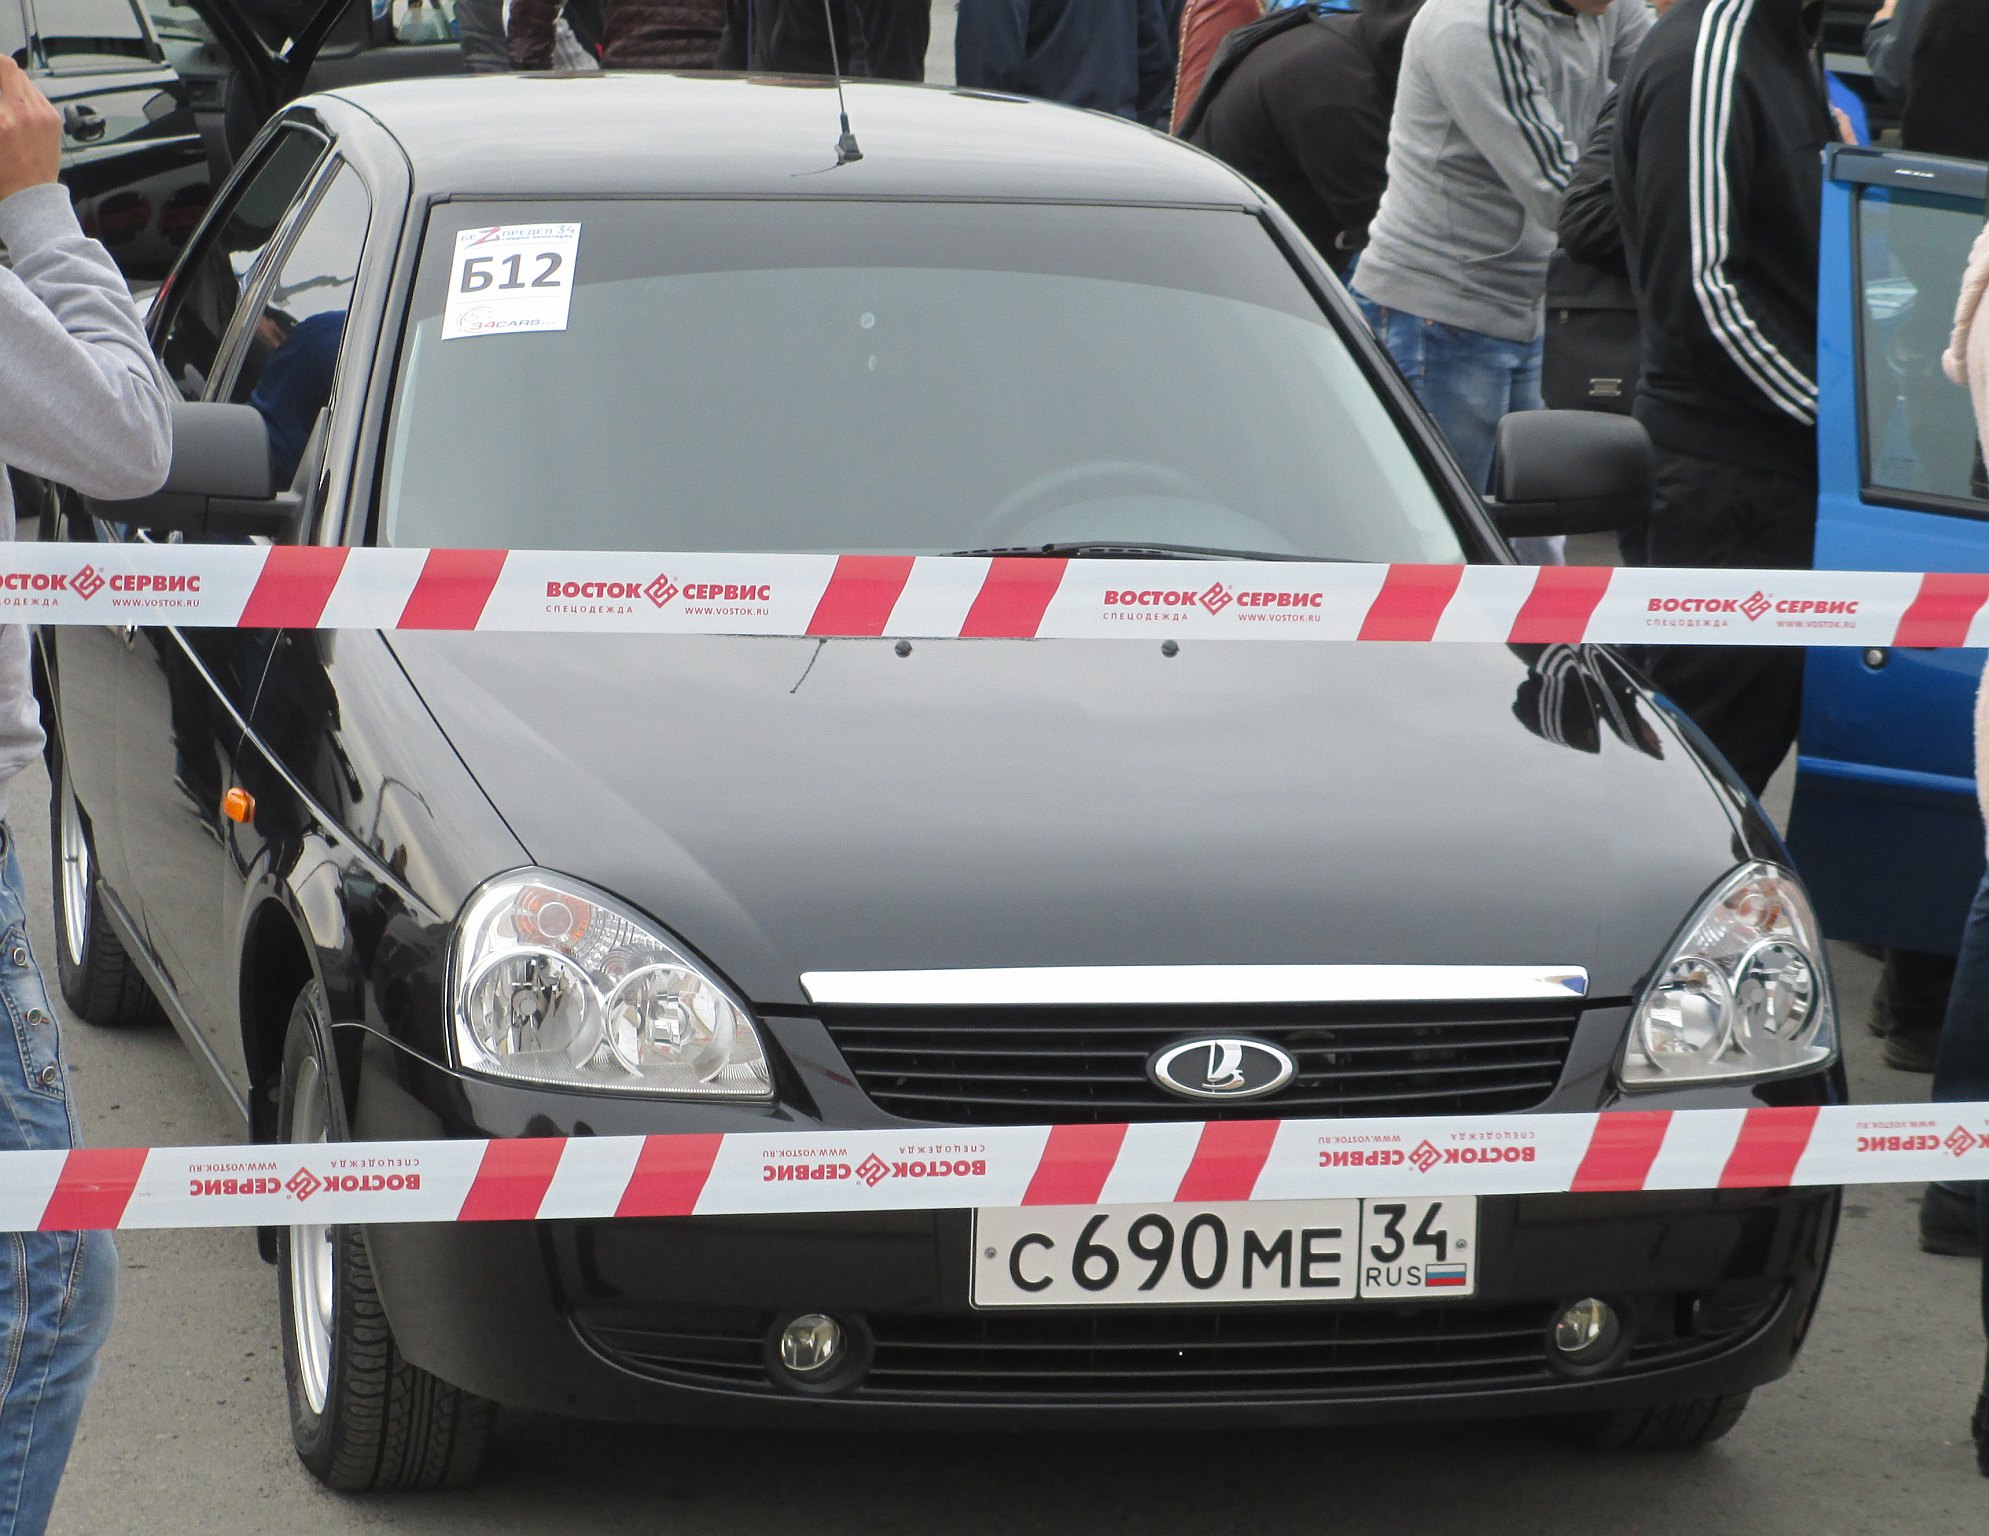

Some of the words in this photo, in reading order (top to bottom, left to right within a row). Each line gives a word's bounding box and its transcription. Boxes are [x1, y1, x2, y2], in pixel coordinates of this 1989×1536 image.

[556, 225, 575, 235] 34
[461, 252, 562, 293] Б12
[0, 574, 68, 590] СТОК
[109, 575, 200, 592] СЕРВИС
[547, 582, 642, 598] ВОСТОК
[683, 584, 770, 601] СЕРВИС
[0, 597, 59, 608] ОДЕЖДА
[1104, 591, 1197, 606] ВОСТОК
[1237, 592, 1323, 607] СЕРВИС
[1648, 598, 1738, 612] ВОСТОК
[1775, 600, 1859, 614] СЕРВИС
[543, 604, 633, 615] СПЕЦОДЕЖДА
[1102, 612, 1189, 622] СПЕЦОДЕЖДА
[1450, 1130, 1536, 1141] СПЕЦОДЕЖДА
[1857, 1135, 1941, 1152] СЕРВИС
[898, 1144, 986, 1155] СПЕЦОДЕЖДА
[1442, 1147, 1535, 1164] ВОСТОК
[330, 1157, 420, 1169] СПЕЦОДЕЖДА
[1319, 1150, 1405, 1167] СЕРВИС
[764, 1164, 851, 1181] СЕРВИС
[892, 1160, 986, 1178] ВОСТОК
[190, 1178, 281, 1196] СЕРВИС
[323, 1174, 420, 1192] ВОСТОК
[1370, 1202, 1447, 1263] 34
[1366, 1266, 1421, 1287] RUS
